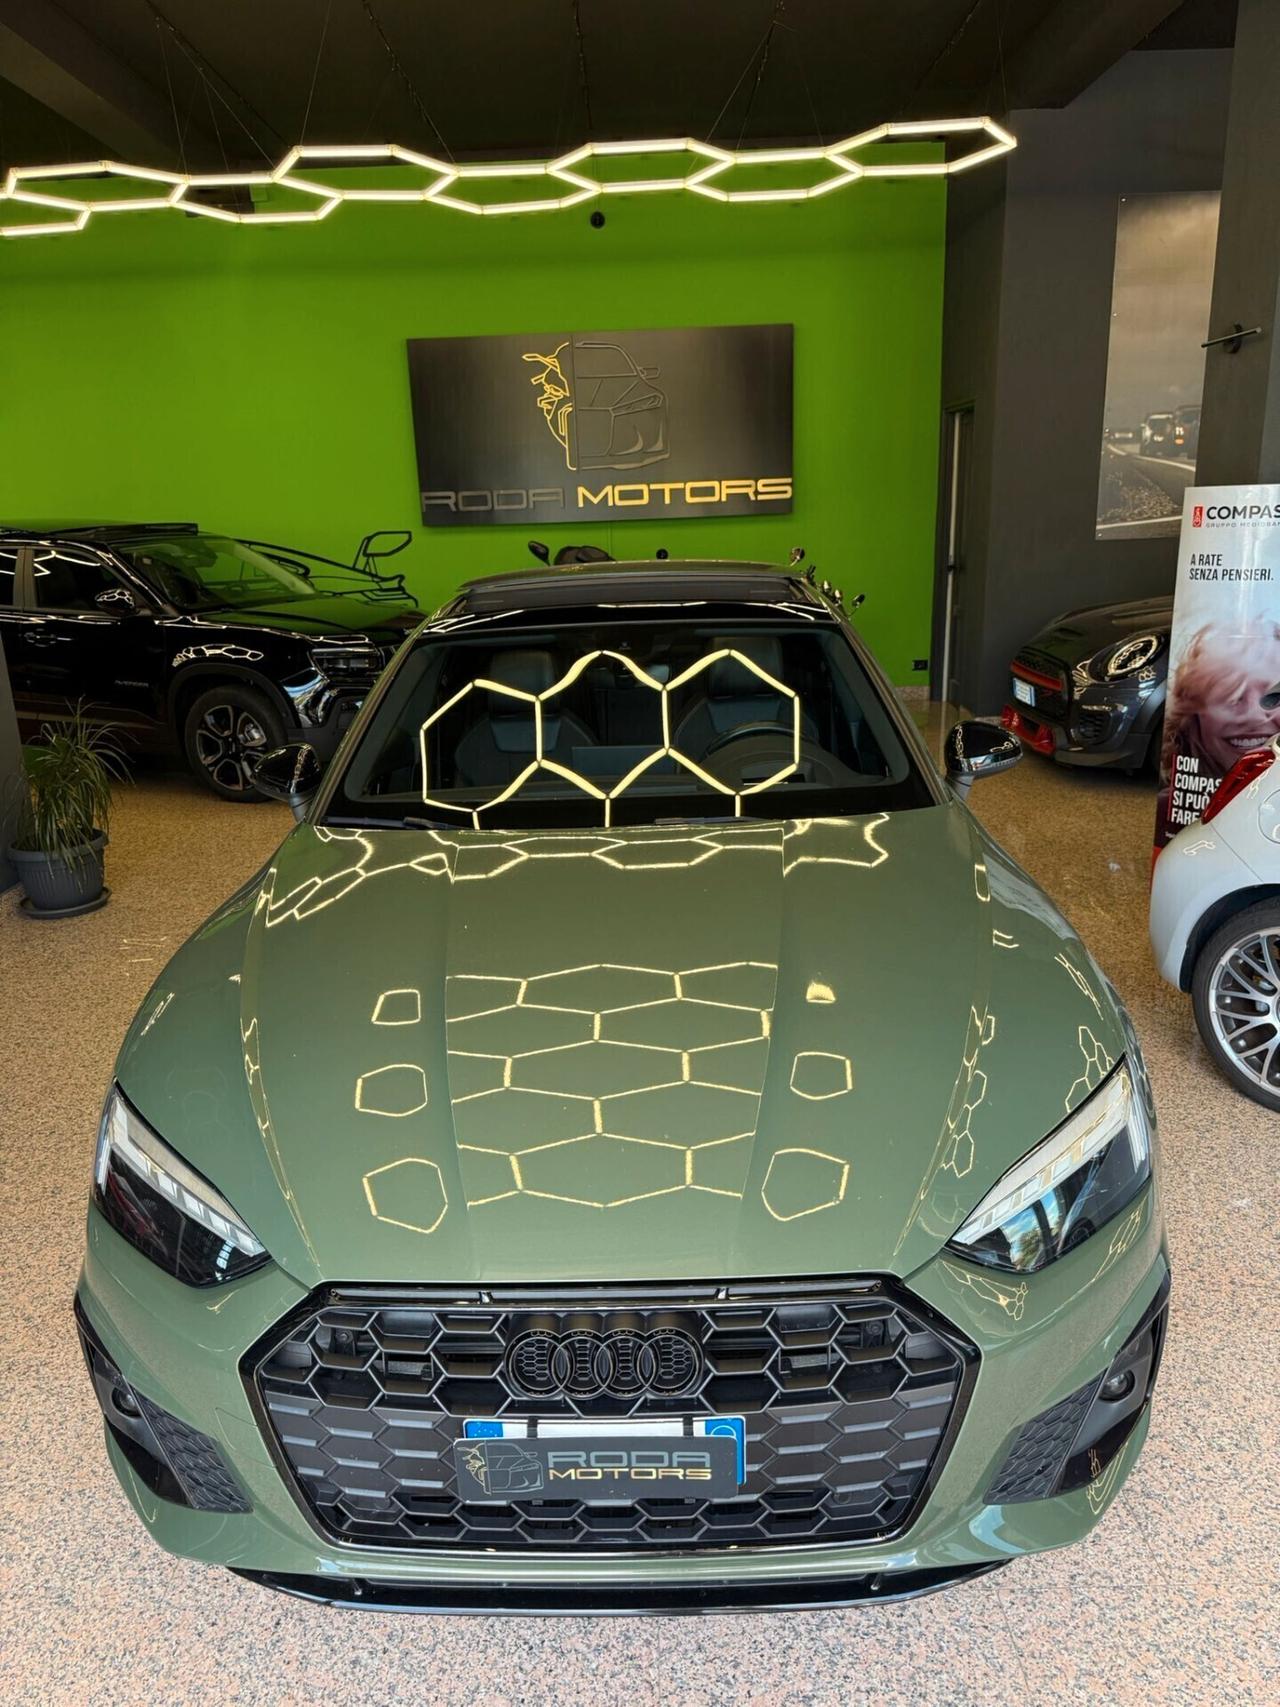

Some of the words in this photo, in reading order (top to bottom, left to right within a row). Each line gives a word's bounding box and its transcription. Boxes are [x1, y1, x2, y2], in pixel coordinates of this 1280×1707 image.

[421, 488, 565, 513] RODA
[577, 477, 793, 508] MOTORS
[1190, 553, 1196, 566] A
[1198, 553, 1222, 566] RATE
[1189, 568, 1218, 581] SENZA
[1221, 568, 1274, 581] PENSIERI.
[1176, 755, 1199, 773] CON
[1172, 791, 1183, 806] SI
[547, 1451, 711, 1468] RODA
[548, 1468, 713, 1480] MOTORS
